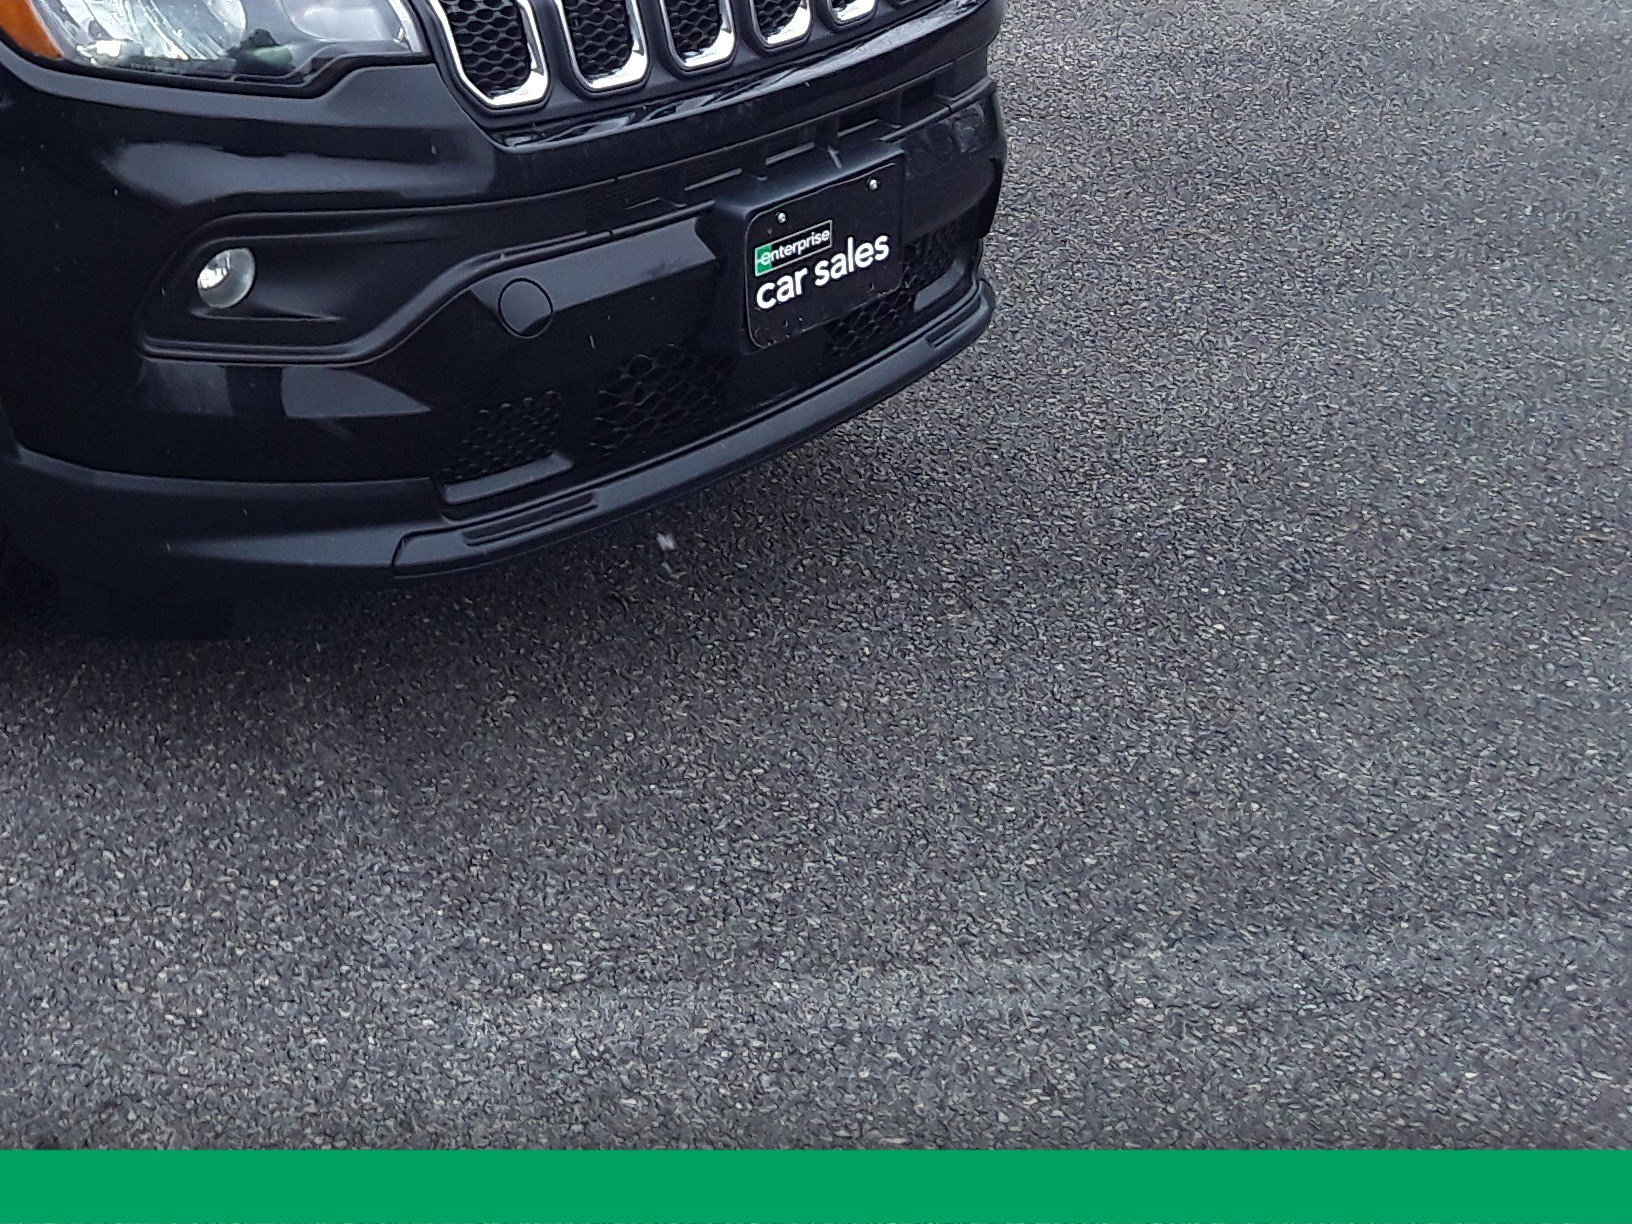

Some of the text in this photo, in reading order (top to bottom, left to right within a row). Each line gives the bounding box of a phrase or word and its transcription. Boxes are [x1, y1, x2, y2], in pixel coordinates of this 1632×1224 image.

[756, 230, 830, 266] enterprise
[757, 236, 889, 309] car sales
